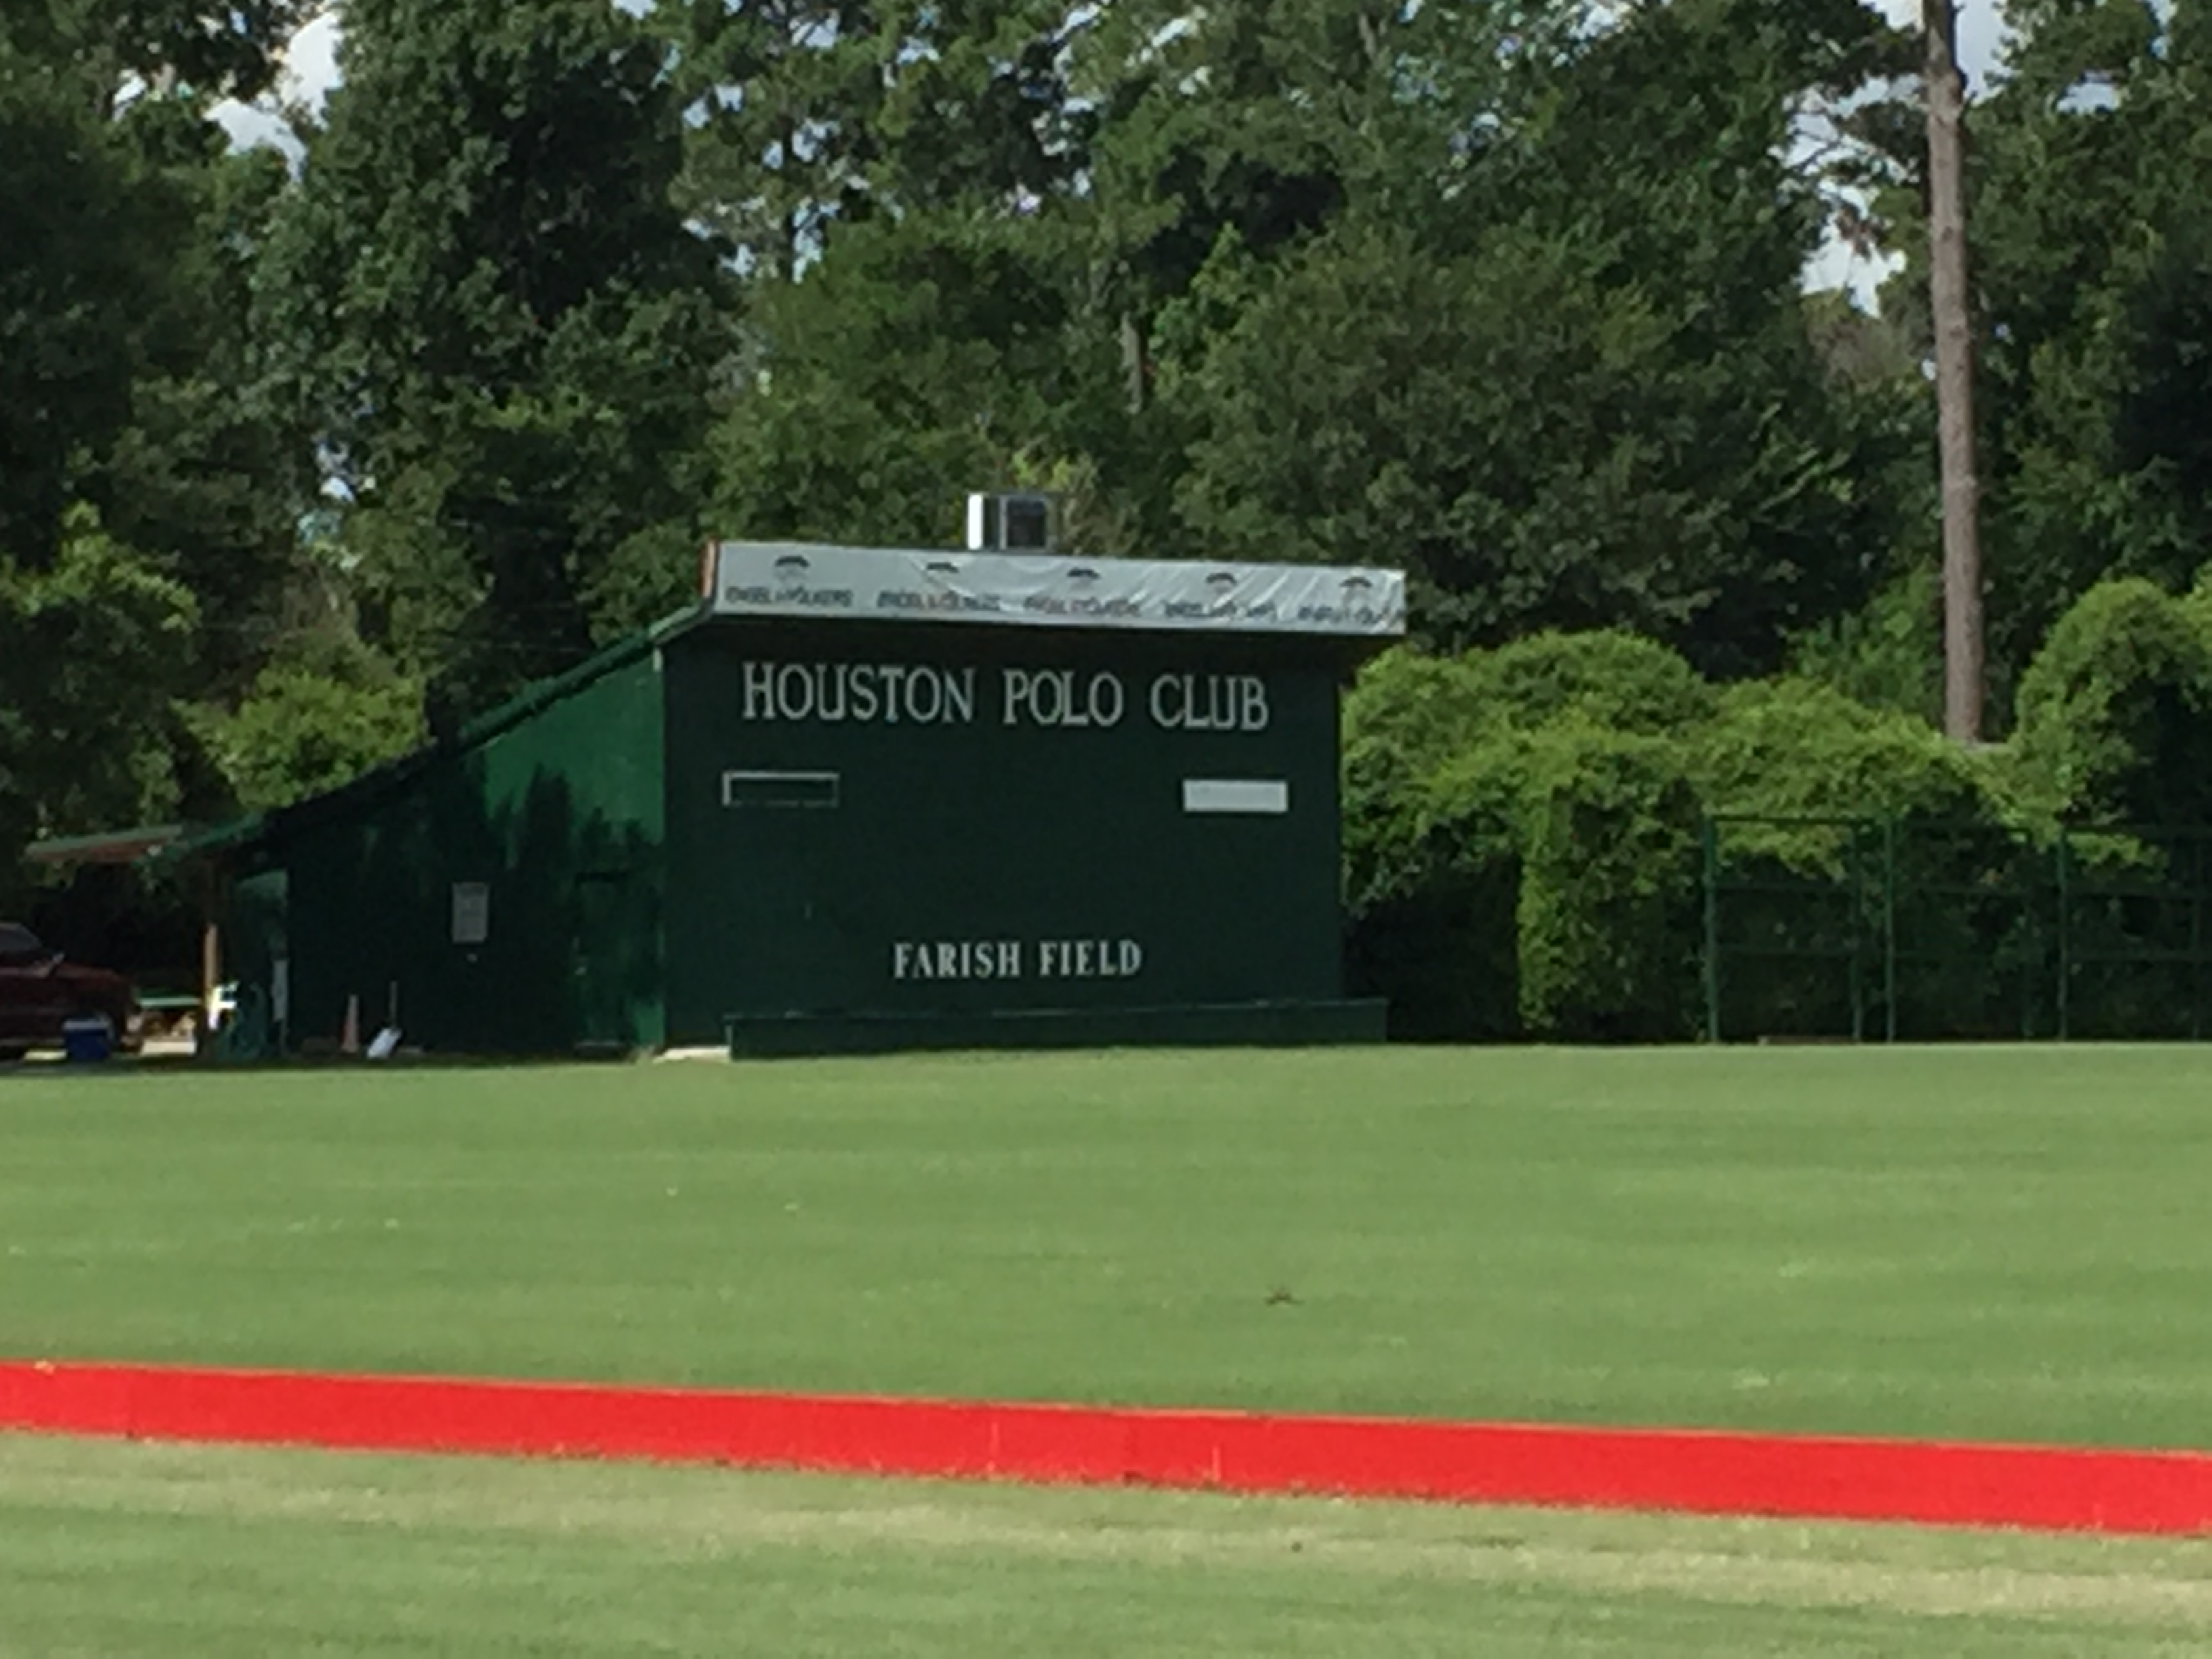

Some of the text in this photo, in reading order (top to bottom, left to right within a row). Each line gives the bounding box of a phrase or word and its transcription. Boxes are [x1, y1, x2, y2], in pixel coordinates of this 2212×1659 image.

[743, 663, 1269, 731] HOUSTON POLO CLUB
[893, 939, 1141, 979] FARISH FIELD
